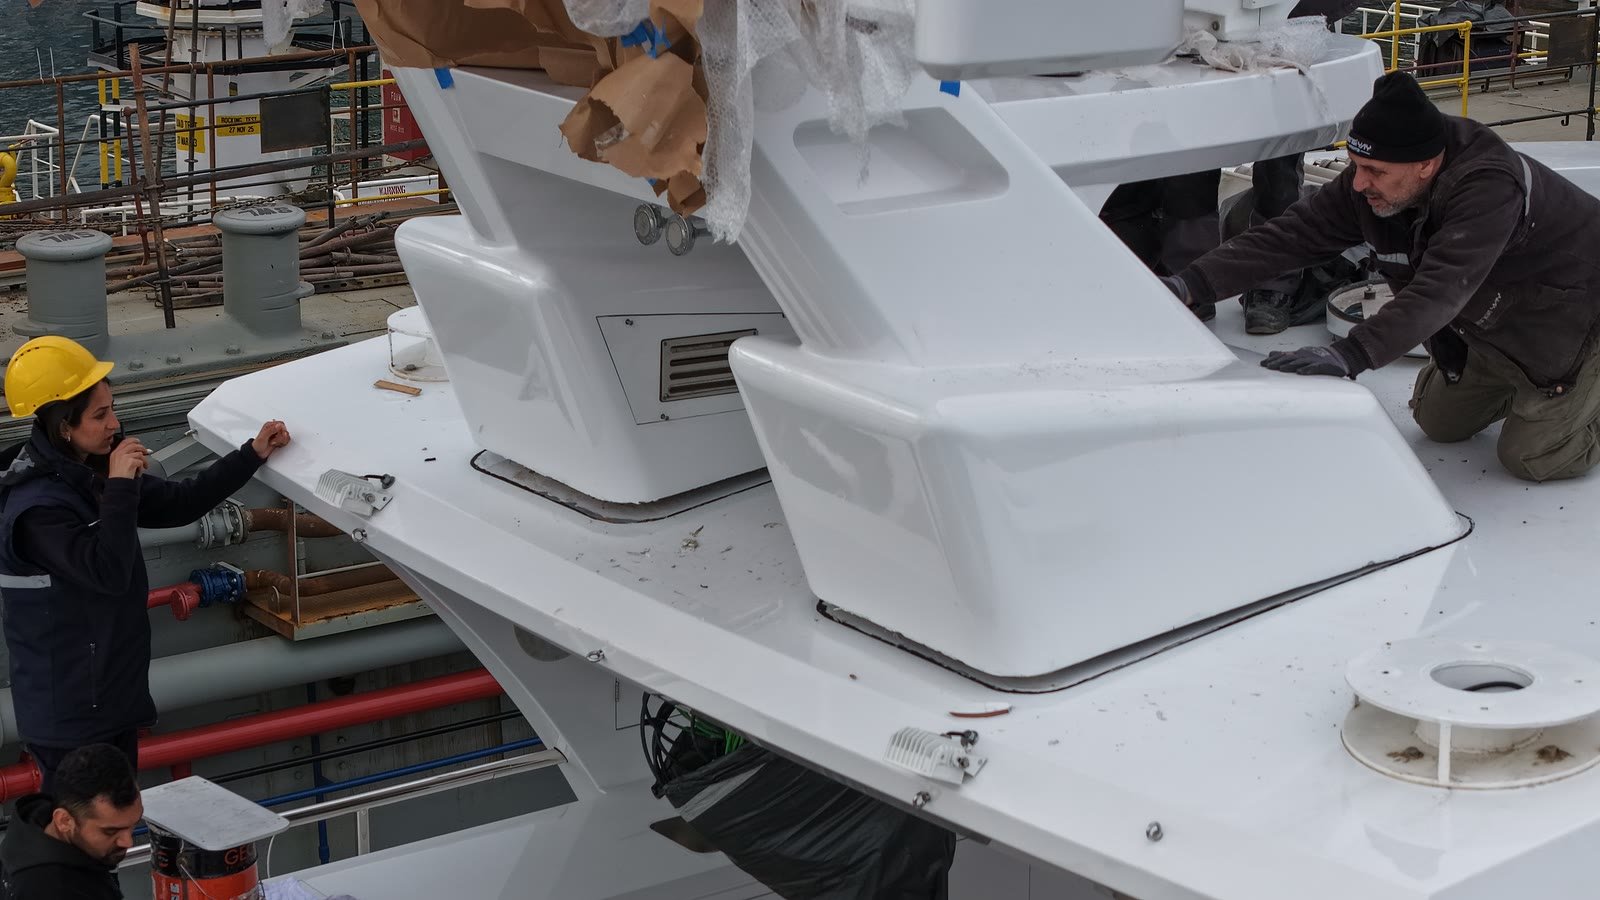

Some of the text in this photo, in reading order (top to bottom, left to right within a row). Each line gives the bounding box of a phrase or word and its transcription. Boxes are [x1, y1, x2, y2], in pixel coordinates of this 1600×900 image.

[379, 185, 406, 195] WARNING
[238, 207, 293, 216] SWL
[39, 232, 95, 243] SWL
